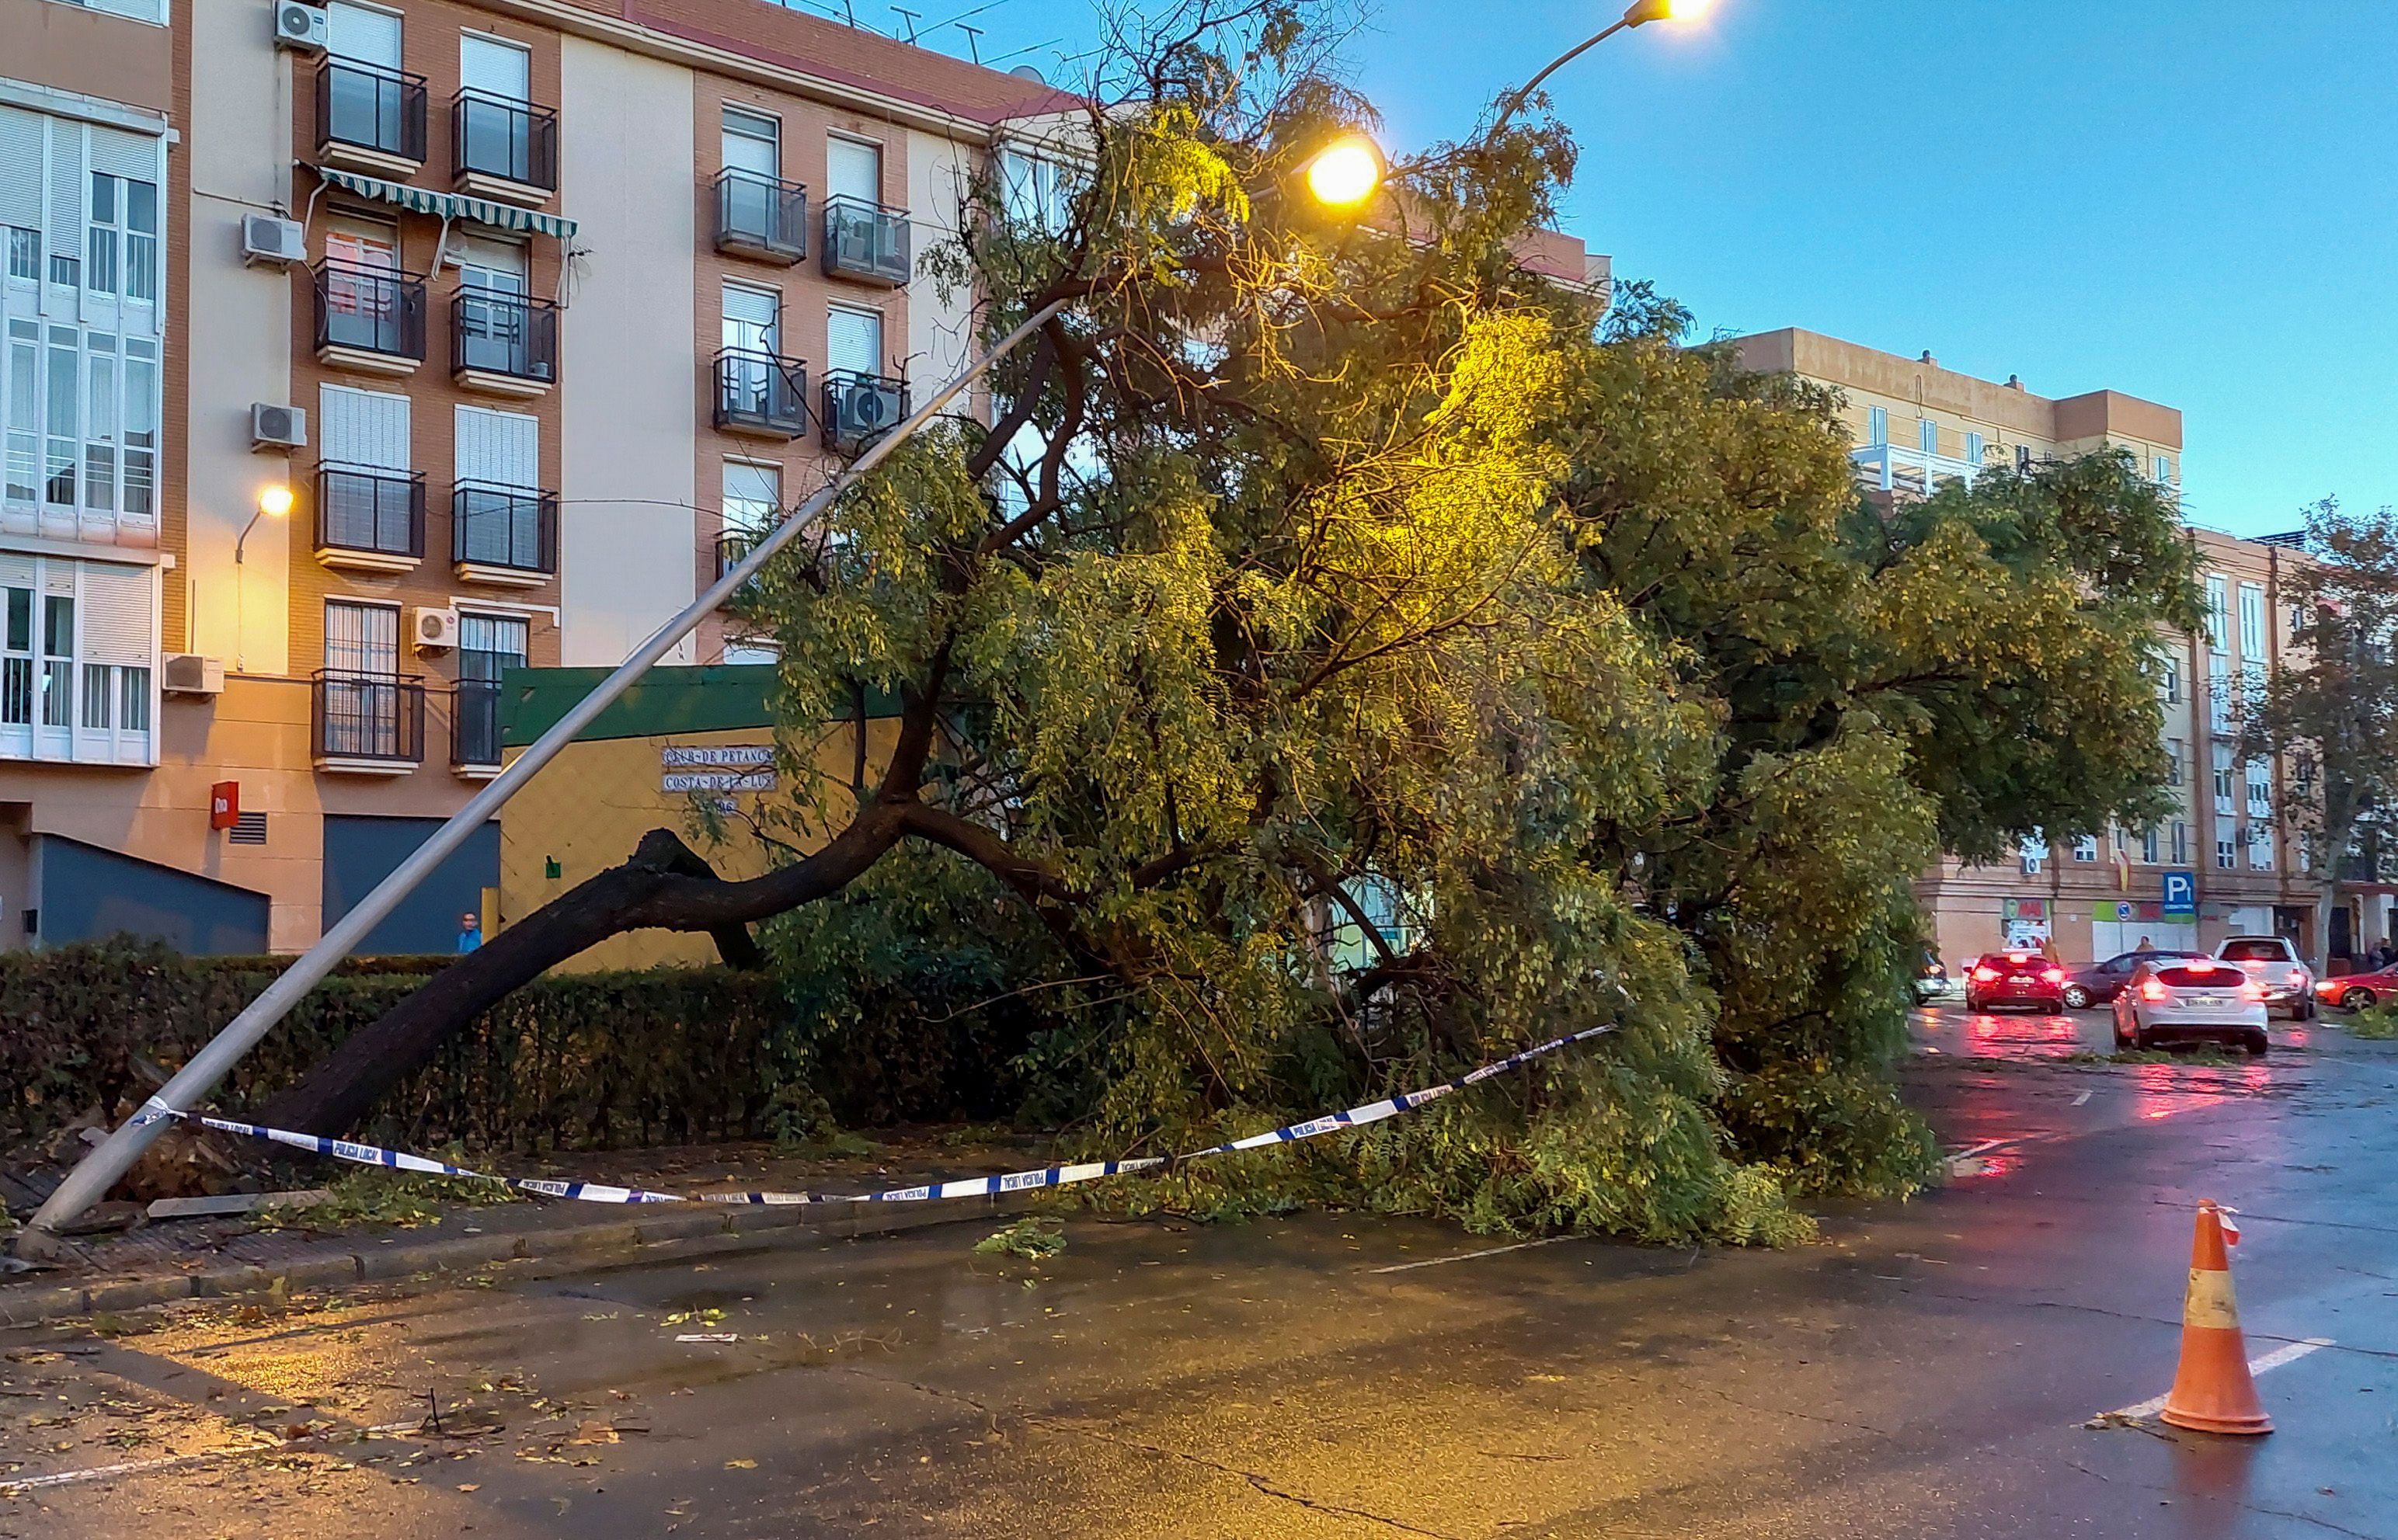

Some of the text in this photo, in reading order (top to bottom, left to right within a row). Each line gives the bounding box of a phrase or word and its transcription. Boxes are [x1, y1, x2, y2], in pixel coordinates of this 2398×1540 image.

[2167, 877, 2188, 902] P
[335, 1142, 378, 1162] POLICIA LOCAL
[1003, 1172, 1044, 1190] POLICIA LOCAL
[905, 1188, 927, 1198] POLICIA
